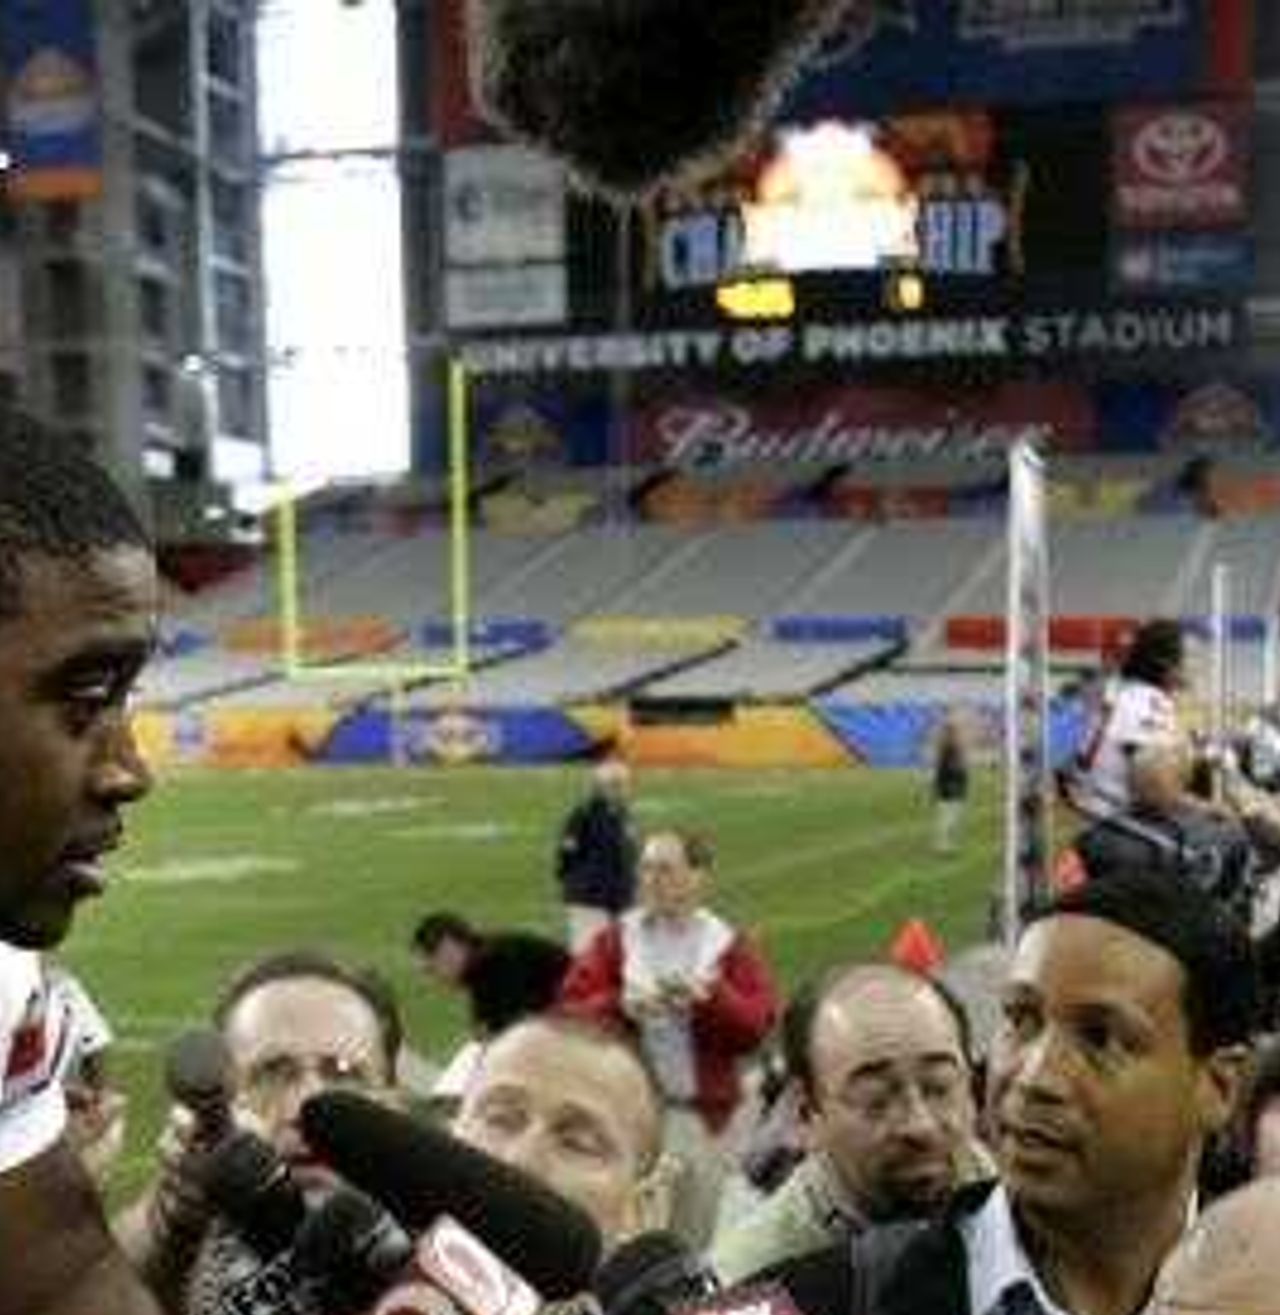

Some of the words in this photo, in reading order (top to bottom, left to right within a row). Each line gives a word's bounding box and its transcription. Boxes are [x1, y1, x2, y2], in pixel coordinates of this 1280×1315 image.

[462, 328, 719, 380] UNIVERSITY
[730, 325, 795, 363] OF
[803, 318, 1010, 362] PHOENIX
[1024, 310, 1234, 354] STADIUM
